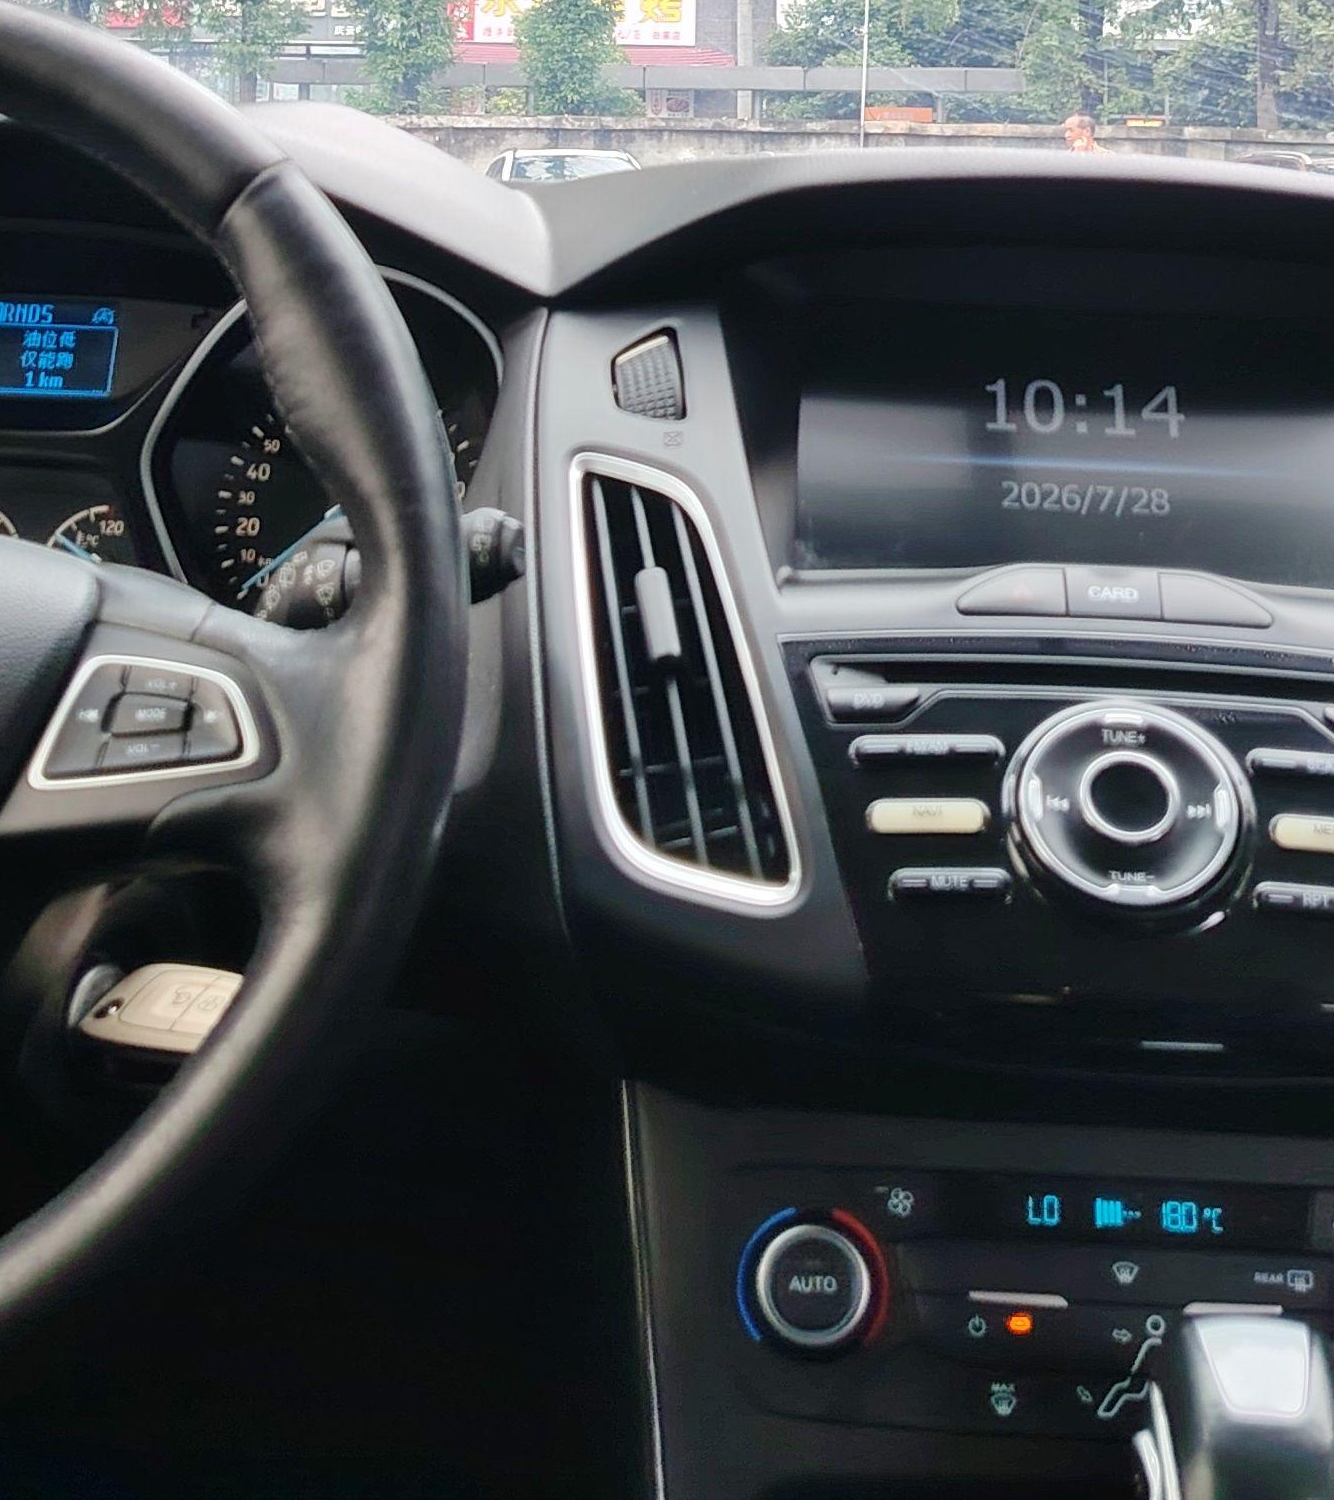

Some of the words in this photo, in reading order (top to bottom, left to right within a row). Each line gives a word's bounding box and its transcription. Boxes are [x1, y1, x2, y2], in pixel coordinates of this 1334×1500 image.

[25, 371, 34, 387] 1
[38, 372, 63, 388] km
[984, 378, 1186, 438] 10:14
[246, 463, 271, 481] 40
[1000, 480, 1171, 518] 2026/7/28
[99, 519, 125, 536] 120
[235, 517, 260, 536] 20
[241, 548, 256, 562] 10
[1087, 585, 1139, 601] CARD
[136, 706, 168, 723] MODE
[930, 874, 968, 889] MUTE
[789, 1275, 837, 1295] AUTO
[1254, 1271, 1284, 1284] REAR
